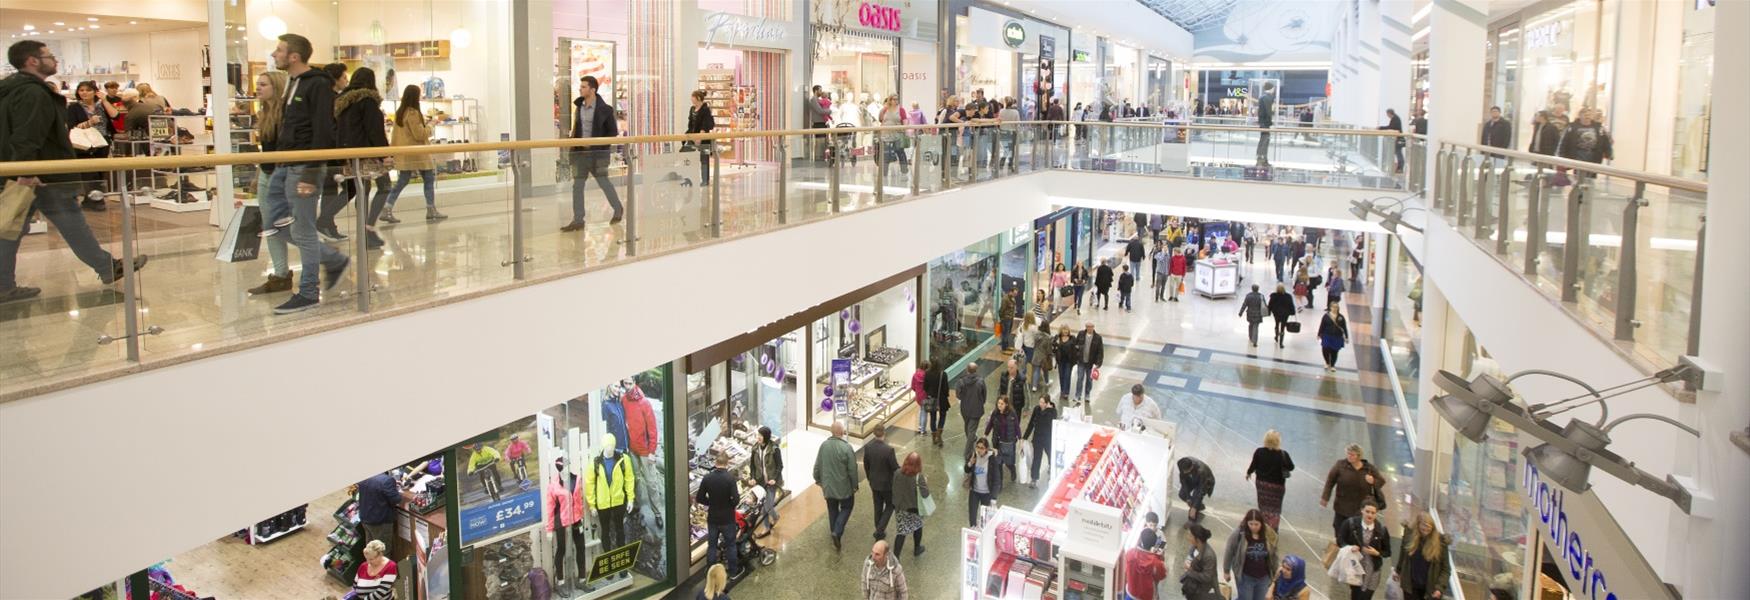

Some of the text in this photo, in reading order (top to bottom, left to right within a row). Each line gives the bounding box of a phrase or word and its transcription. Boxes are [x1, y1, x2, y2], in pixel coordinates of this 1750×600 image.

[858, 3, 901, 32] oasis
[902, 72, 927, 80] oasis
[1227, 87, 1249, 97] M&S
[1521, 459, 1619, 600] motherc
[598, 550, 630, 567] BE SAFE
[598, 559, 630, 574] BE SEEN
